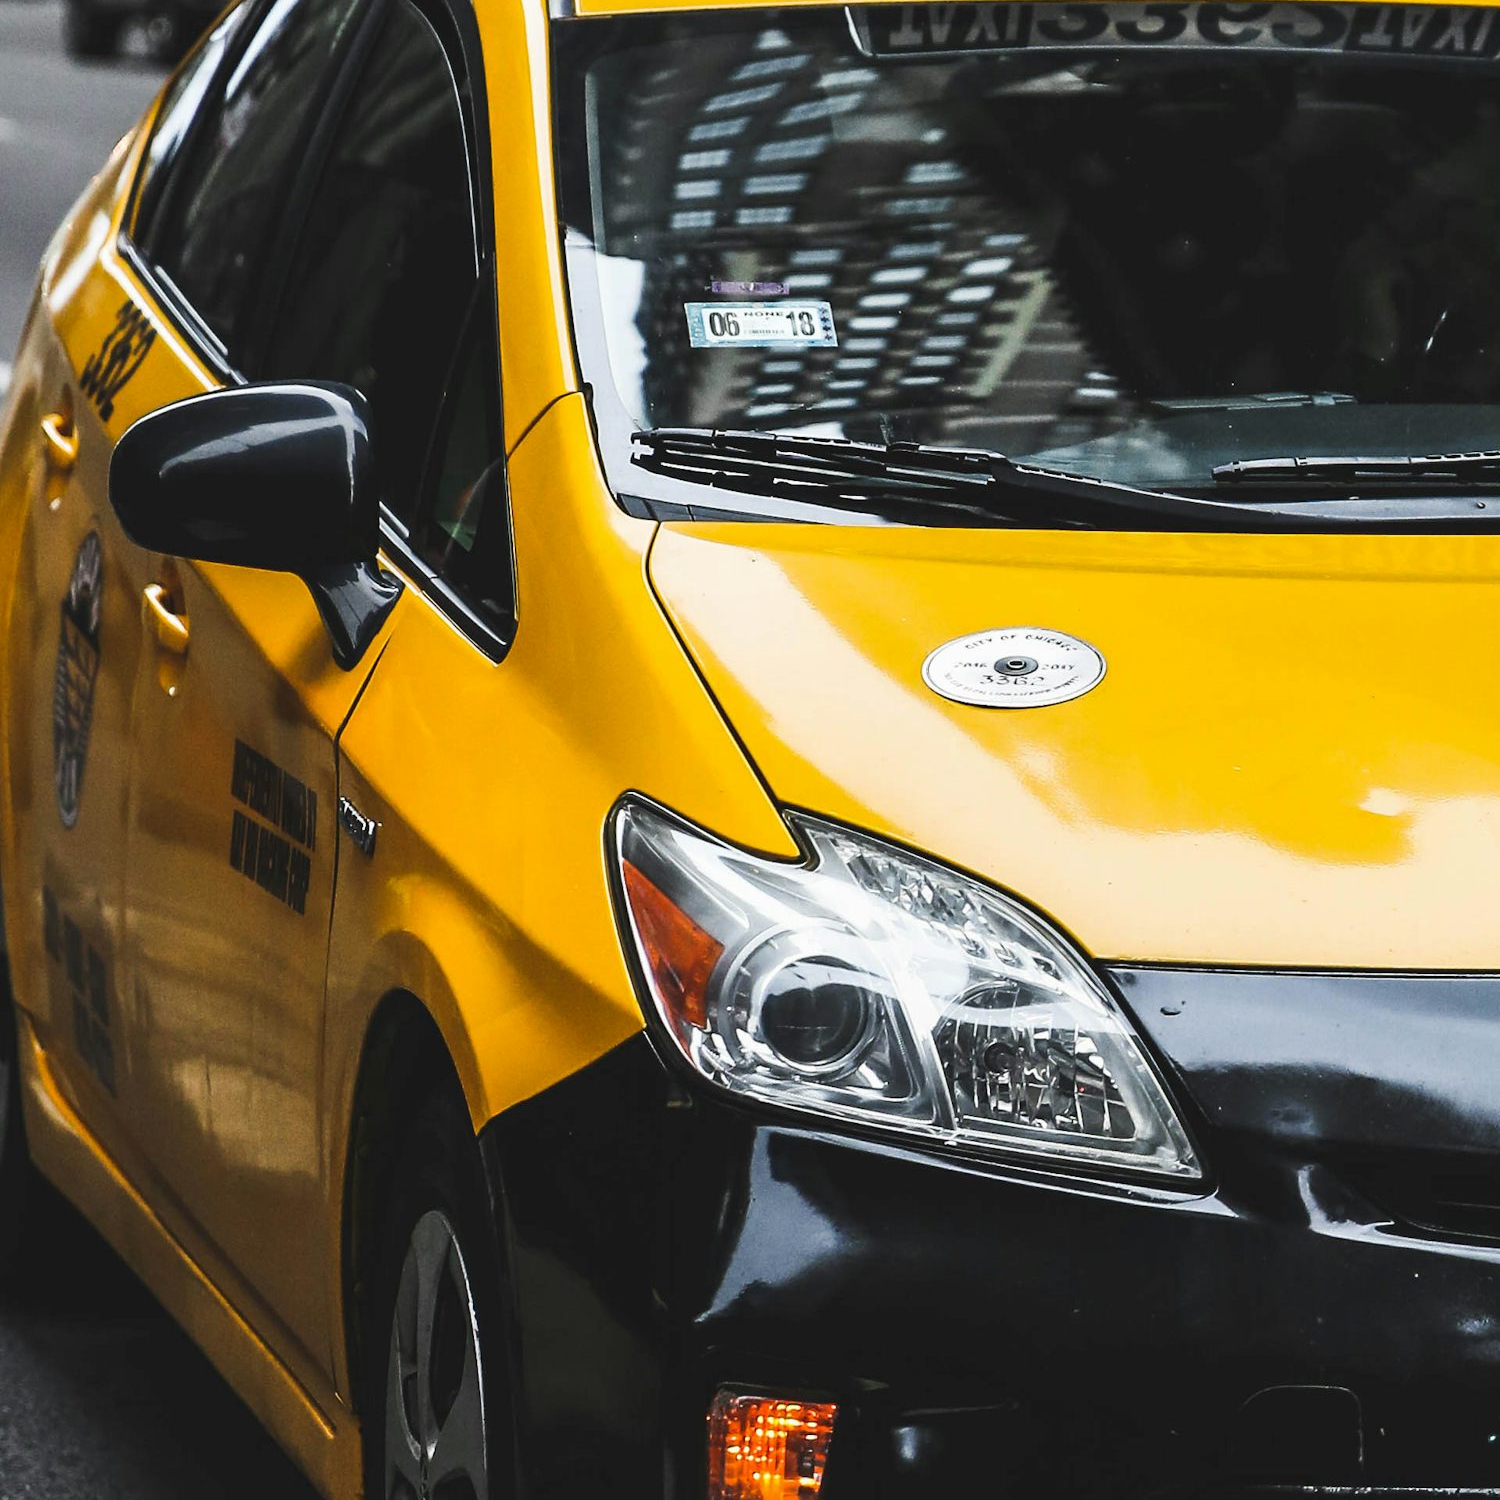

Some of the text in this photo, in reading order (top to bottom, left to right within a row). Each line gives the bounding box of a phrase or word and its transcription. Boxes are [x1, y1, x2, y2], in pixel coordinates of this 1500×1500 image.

[709, 312, 740, 336] 06
[786, 311, 815, 336] 18
[965, 638, 992, 649] CITY
[979, 675, 1045, 686] 3362
